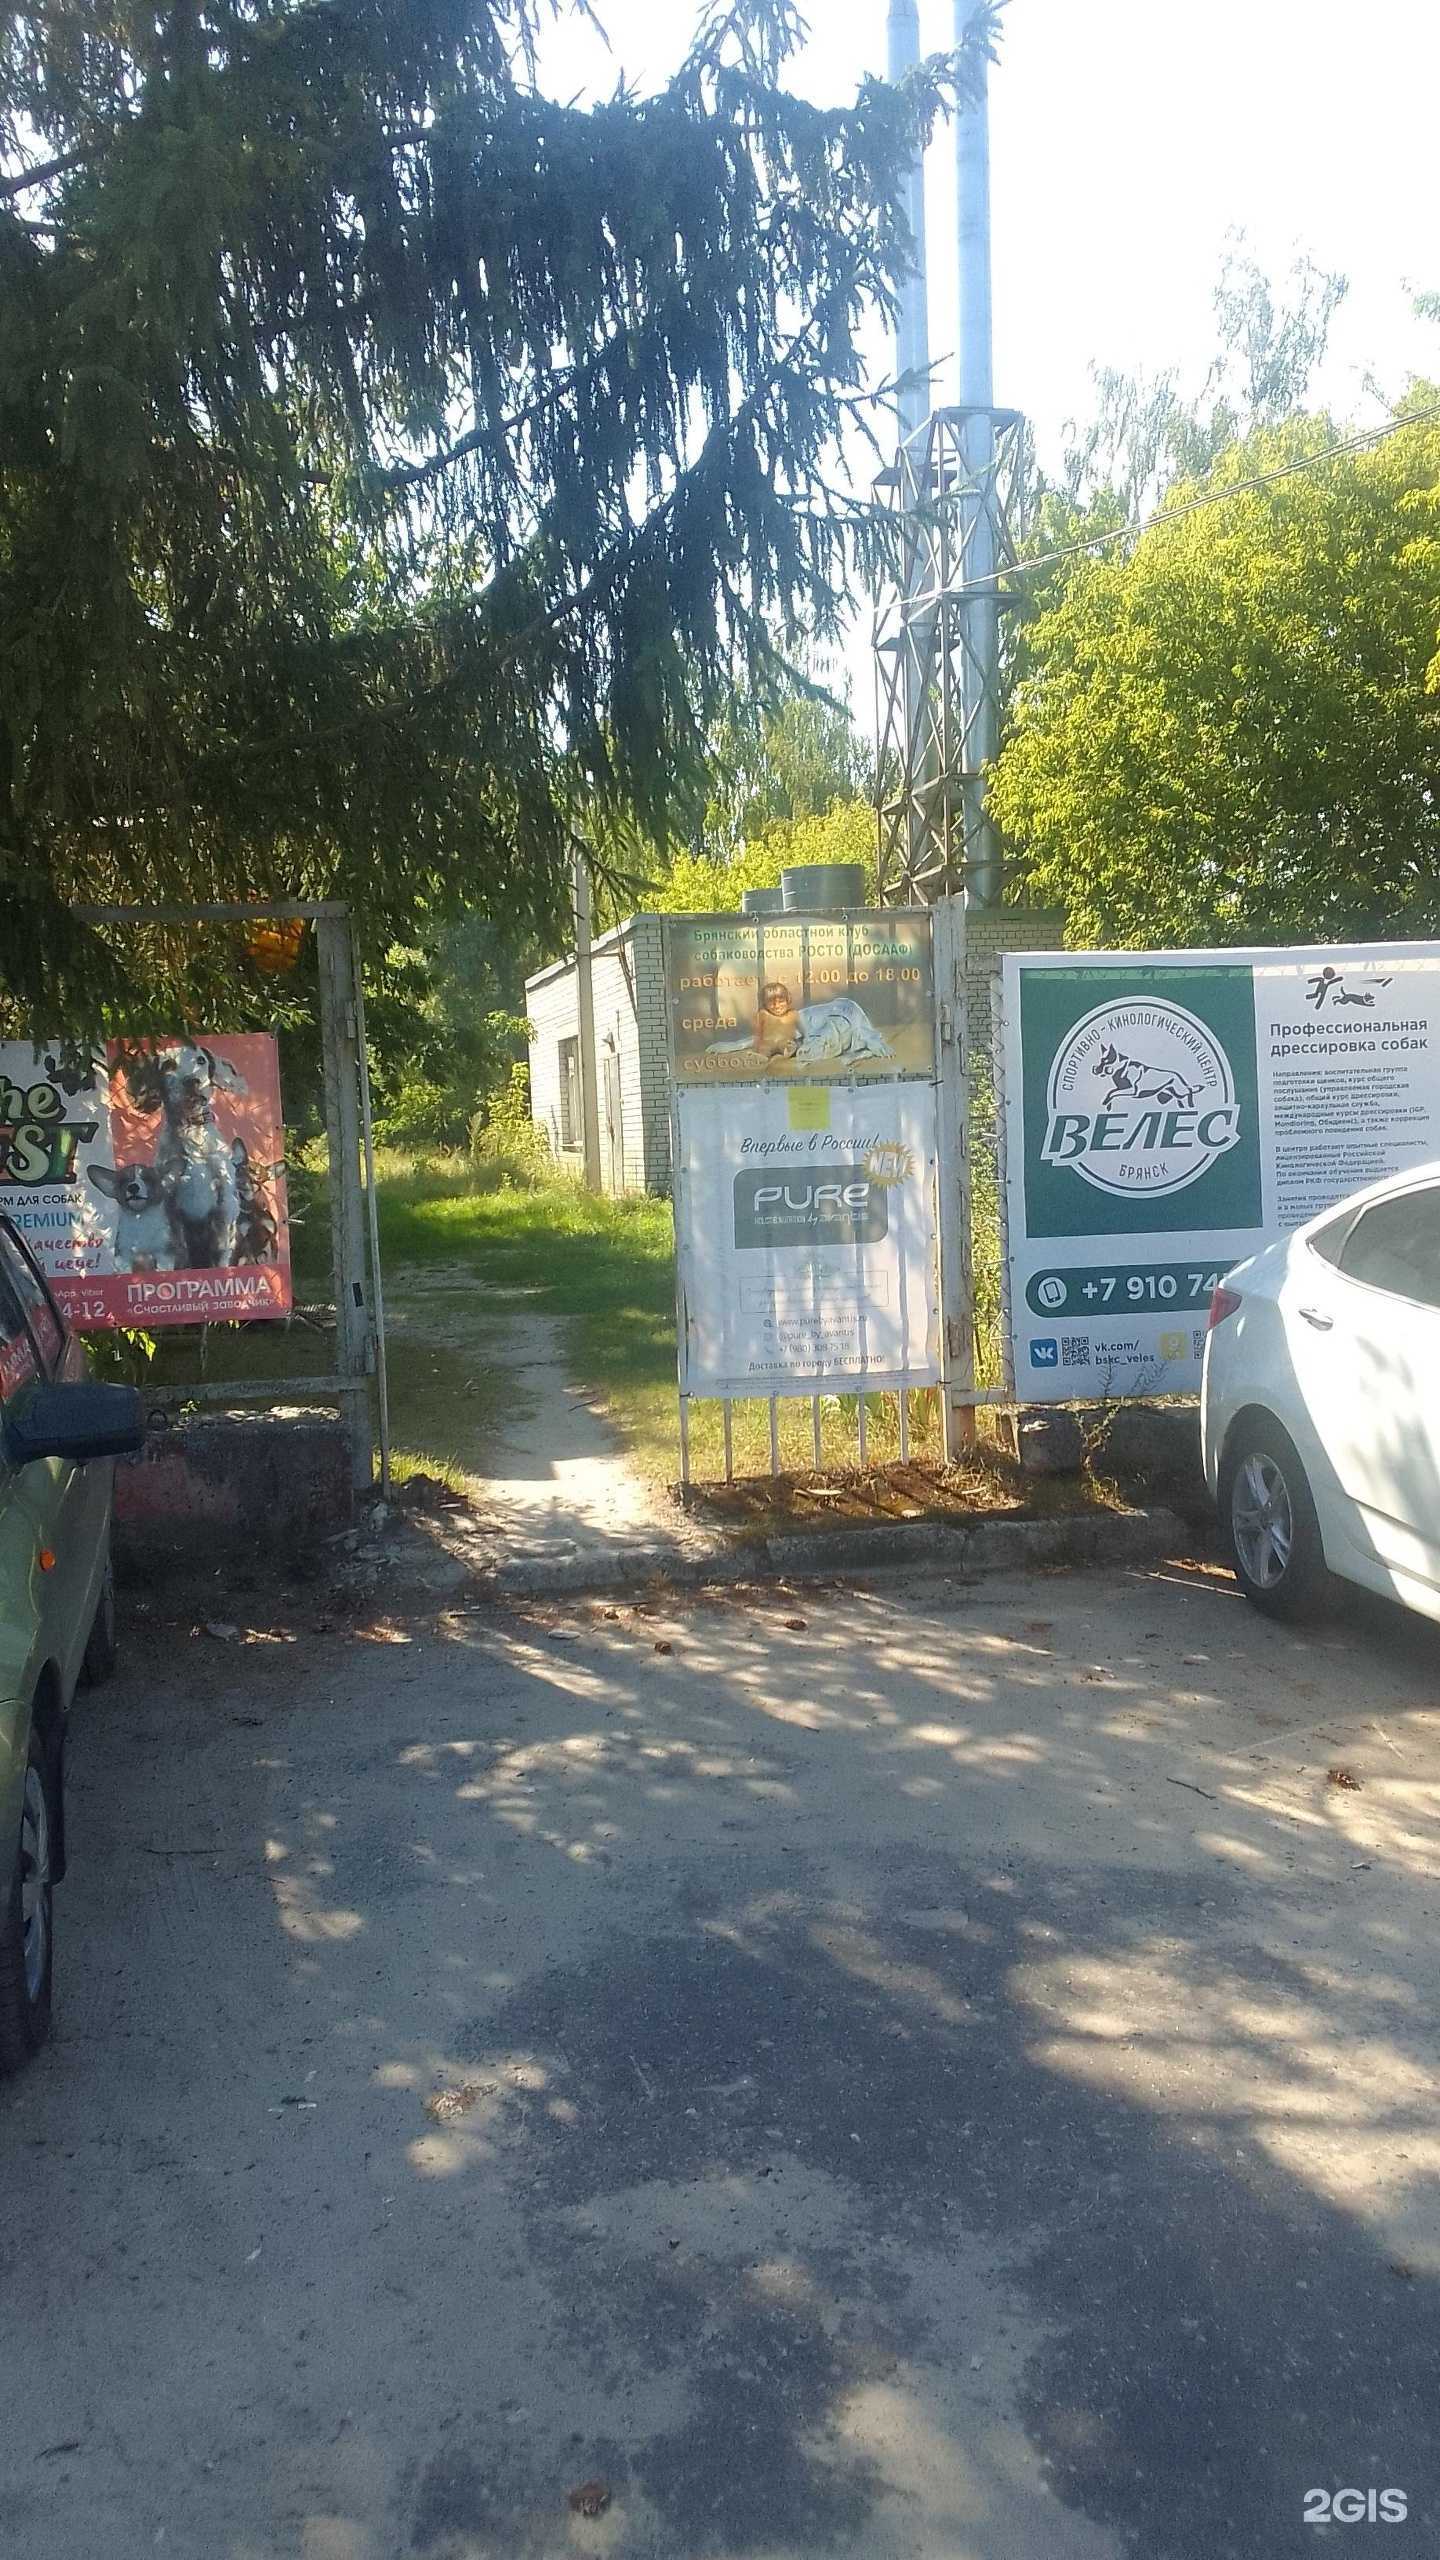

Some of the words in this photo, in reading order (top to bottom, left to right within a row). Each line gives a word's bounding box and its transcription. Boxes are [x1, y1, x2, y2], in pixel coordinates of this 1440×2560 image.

[694, 928, 757, 943] Брянский
[764, 926, 834, 940] областной
[839, 926, 869, 939] клуб
[694, 947, 794, 962] собаководства
[799, 944, 844, 958] РОСТО
[680, 973, 759, 991] работае
[796, 969, 841, 984] 12.00
[847, 970, 869, 984] до
[875, 967, 921, 982] 18.00
[682, 1016, 737, 1032] среда
[1270, 1019, 1428, 1038] Профессиональная
[1062, 1028, 1101, 1092] СПОРТИВНО
[1107, 1012, 1203, 1056] КИНОЛОГИЧЕСКИЙ
[1195, 1050, 1218, 1088] ЦЕНТР
[1270, 1040, 1376, 1058] дрессировка
[1381, 1036, 1429, 1051] собак
[0, 1076, 63, 1120] he
[1049, 1109, 1235, 1159] ВЕЛЕС
[740, 1134, 804, 1157] Впервые
[809, 1133, 819, 1151] в
[821, 1133, 880, 1150] России!
[1119, 1162, 1169, 1181] БРЯНСК
[16, 1195, 39, 1207] ДЛЯ
[42, 1194, 82, 1205] СОБАК
[12, 1211, 84, 1229] REMIUM
[127, 1276, 272, 1303] ПРОГРАММА
[1081, 1277, 1117, 1302] +7
[1126, 1274, 1178, 1300] 910
[1187, 1271, 1229, 1298] 74
[1094, 1340, 1140, 1352] vk.com/
[748, 1361, 788, 1372] Доставка
[1095, 1353, 1155, 1366] bskc_veles
